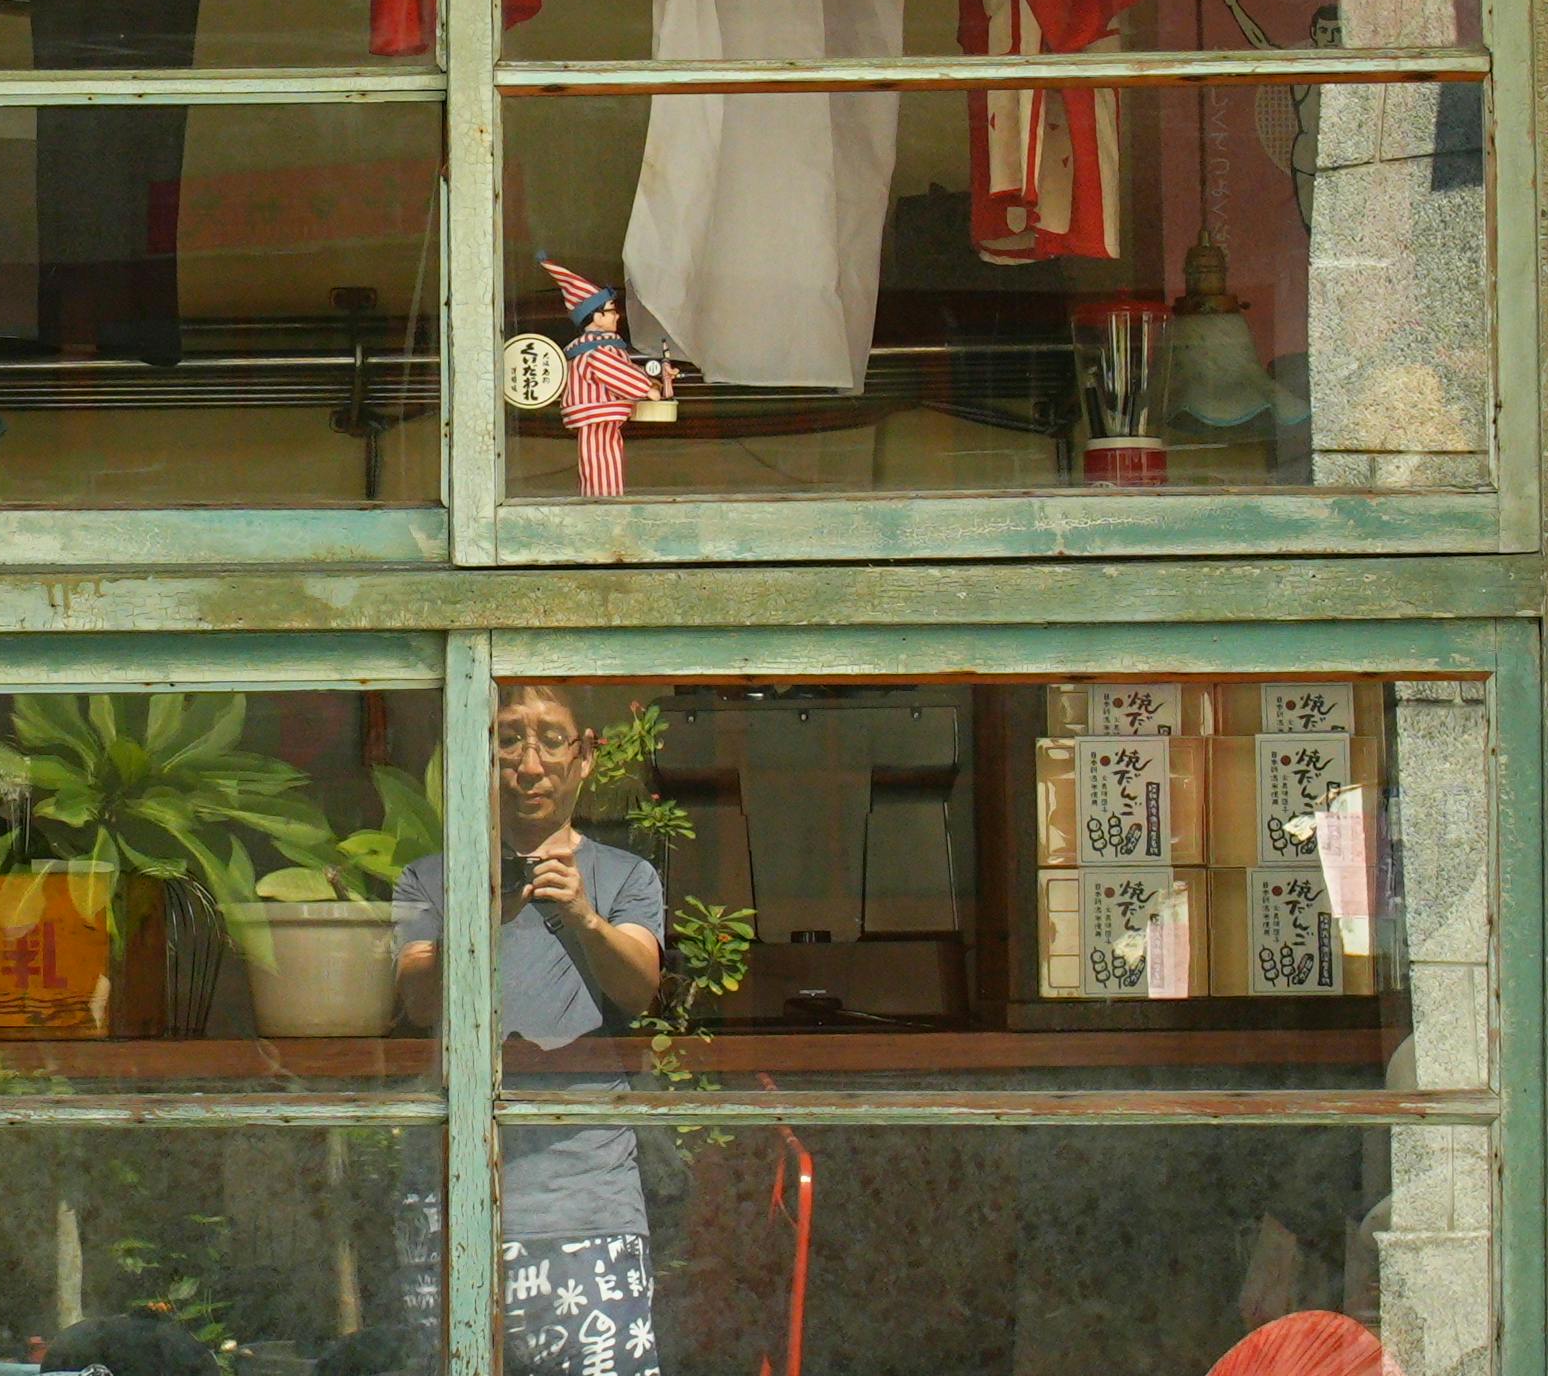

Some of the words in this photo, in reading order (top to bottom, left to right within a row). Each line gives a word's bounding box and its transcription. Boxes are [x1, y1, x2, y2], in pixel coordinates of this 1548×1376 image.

[519, 342, 540, 402] くいだおれ
[1112, 746, 1153, 817] 焼だんご
[1292, 746, 1334, 816] 焼だんご
[1284, 878, 1325, 946] 焼だんご
